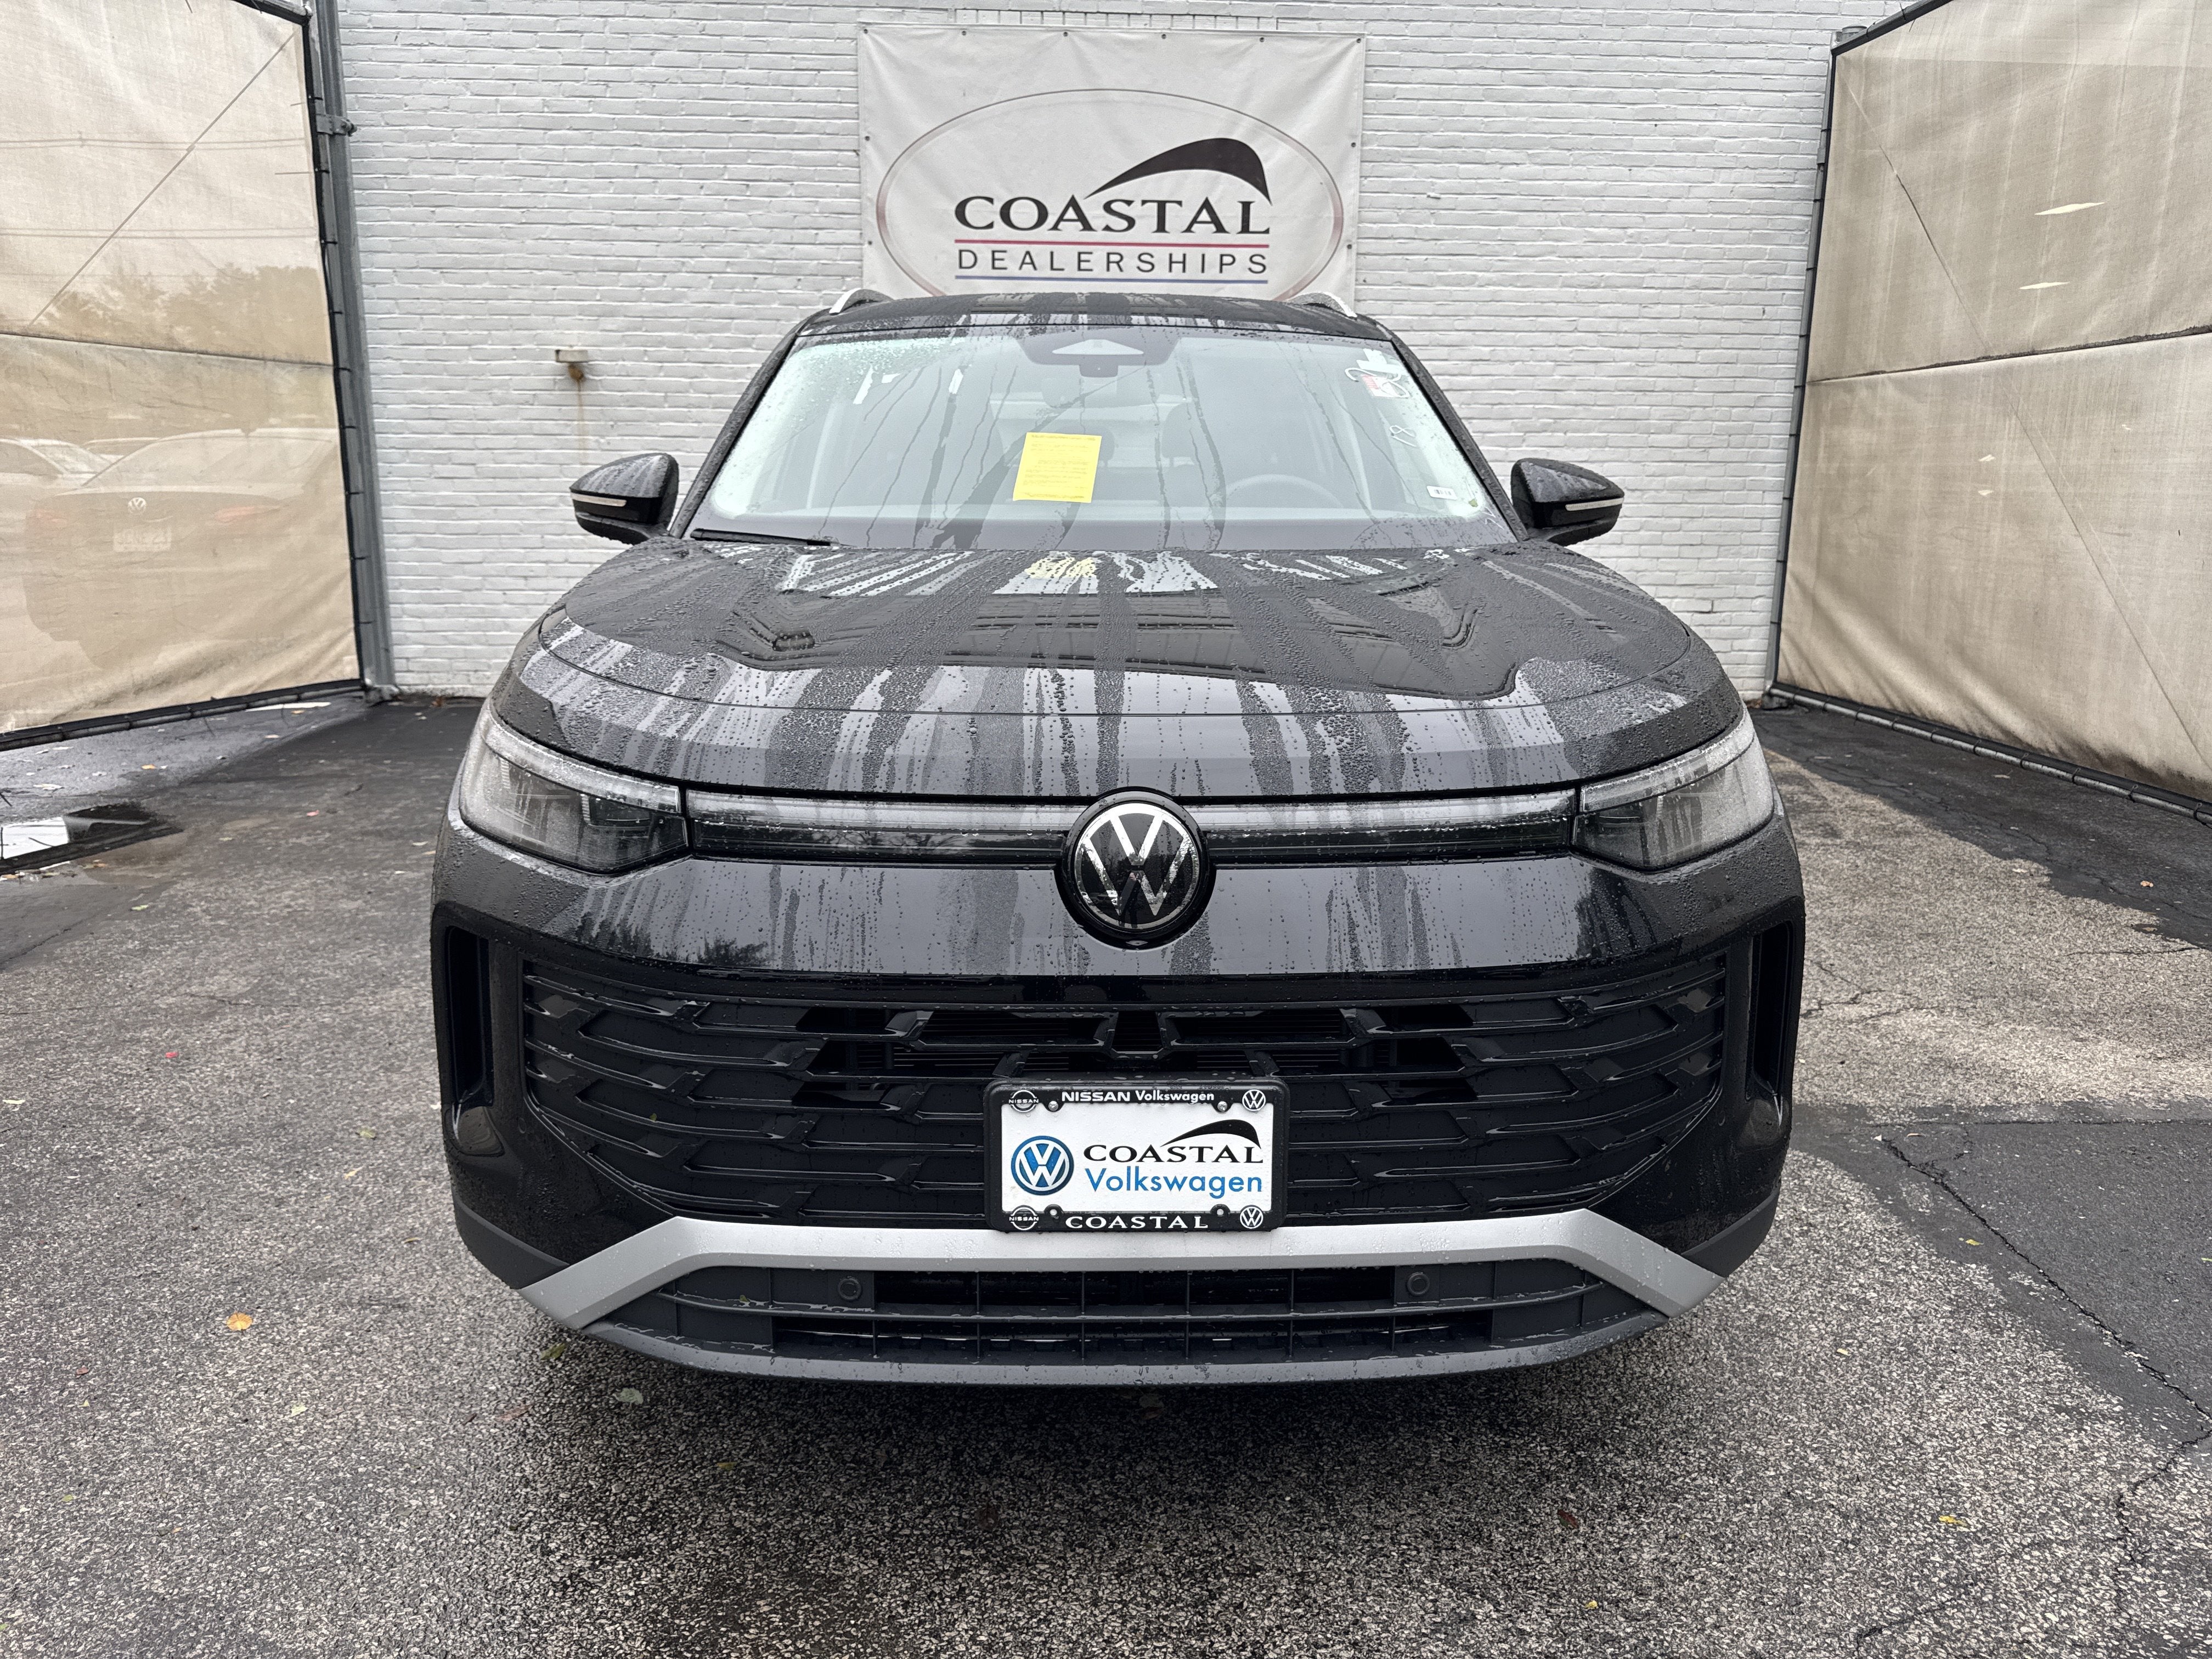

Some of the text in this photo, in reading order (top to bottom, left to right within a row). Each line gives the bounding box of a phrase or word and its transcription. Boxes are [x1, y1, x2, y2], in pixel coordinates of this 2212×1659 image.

[954, 194, 1271, 235] COASTAL
[957, 249, 1268, 275] DEALERSHIPS
[1074, 803, 1200, 929] VW
[1062, 1090, 1214, 1102] NISSAN Volkswagen
[1243, 1090, 1266, 1111] VW
[1011, 1136, 1074, 1195] VW
[1084, 1144, 1263, 1164] COASTAL
[1085, 1166, 1262, 1199] Volkswagen
[1065, 1216, 1208, 1229] COASTAL
[1240, 1205, 1264, 1229] VW
